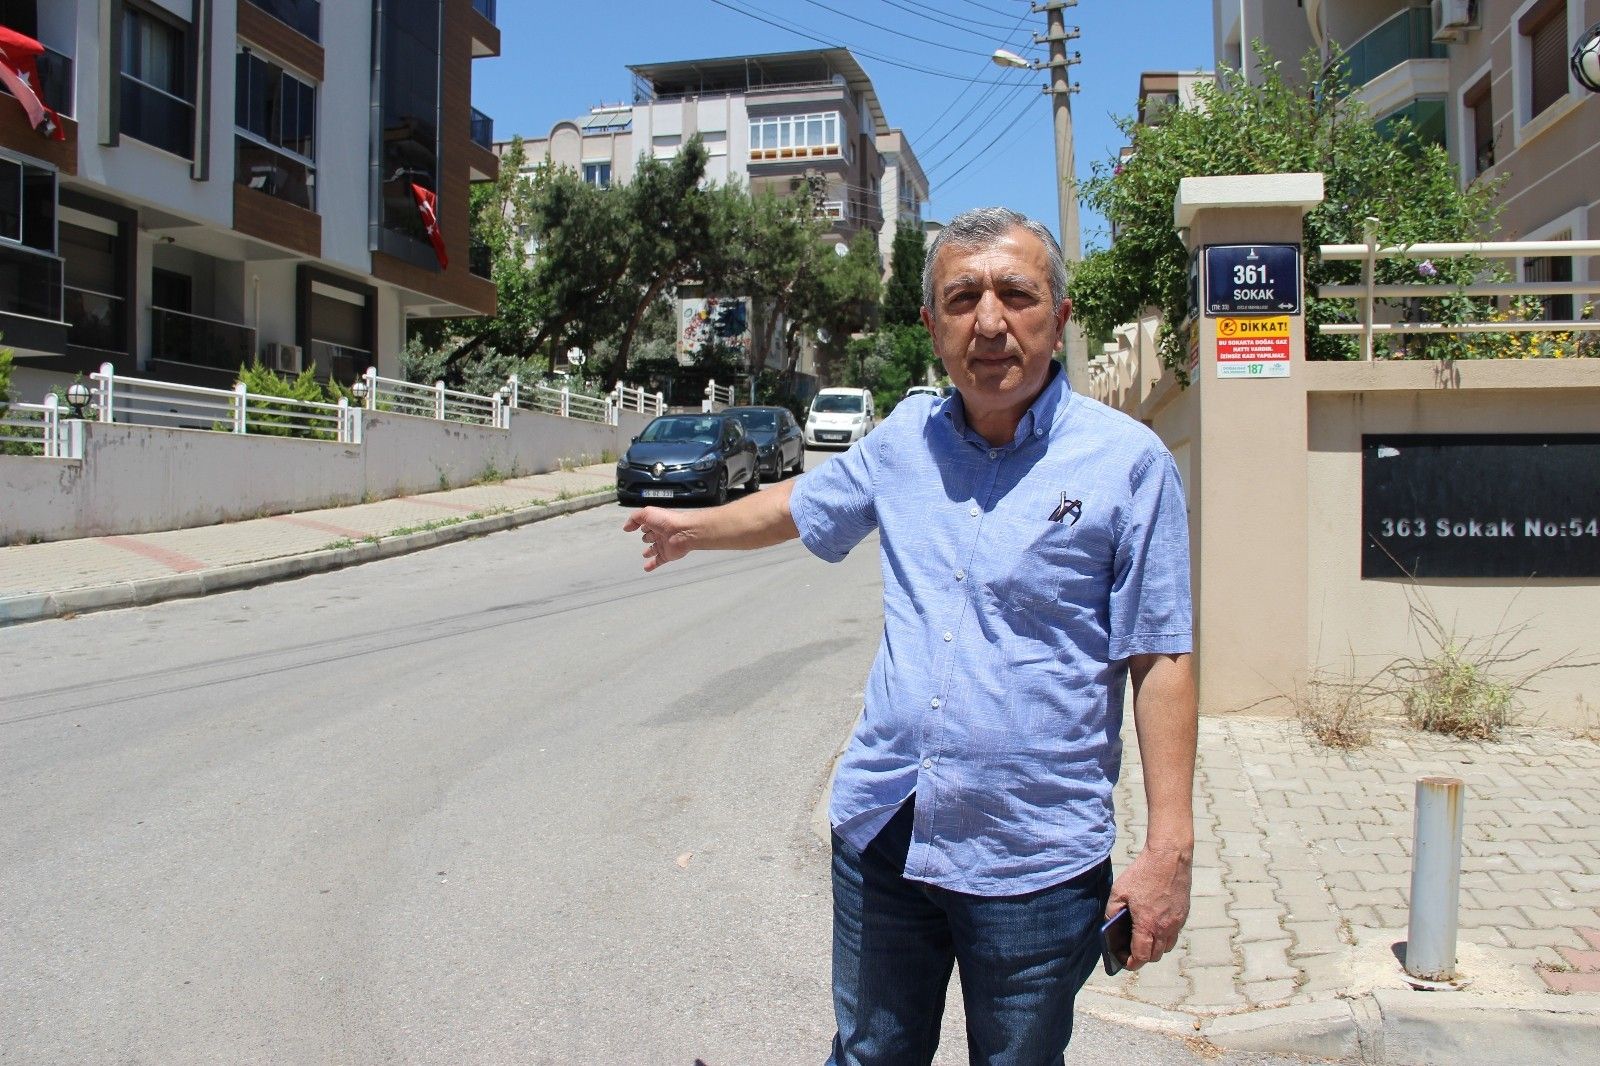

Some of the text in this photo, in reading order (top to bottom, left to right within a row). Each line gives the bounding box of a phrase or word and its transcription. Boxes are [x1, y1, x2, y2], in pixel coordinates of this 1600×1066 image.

[1233, 264, 1275, 285] 361.
[1233, 289, 1275, 301] SOKAK
[1240, 320, 1288, 332] DİKKAT!
[1247, 363, 1264, 375] 187
[1381, 517, 1598, 537] 363 Sokak No:54
